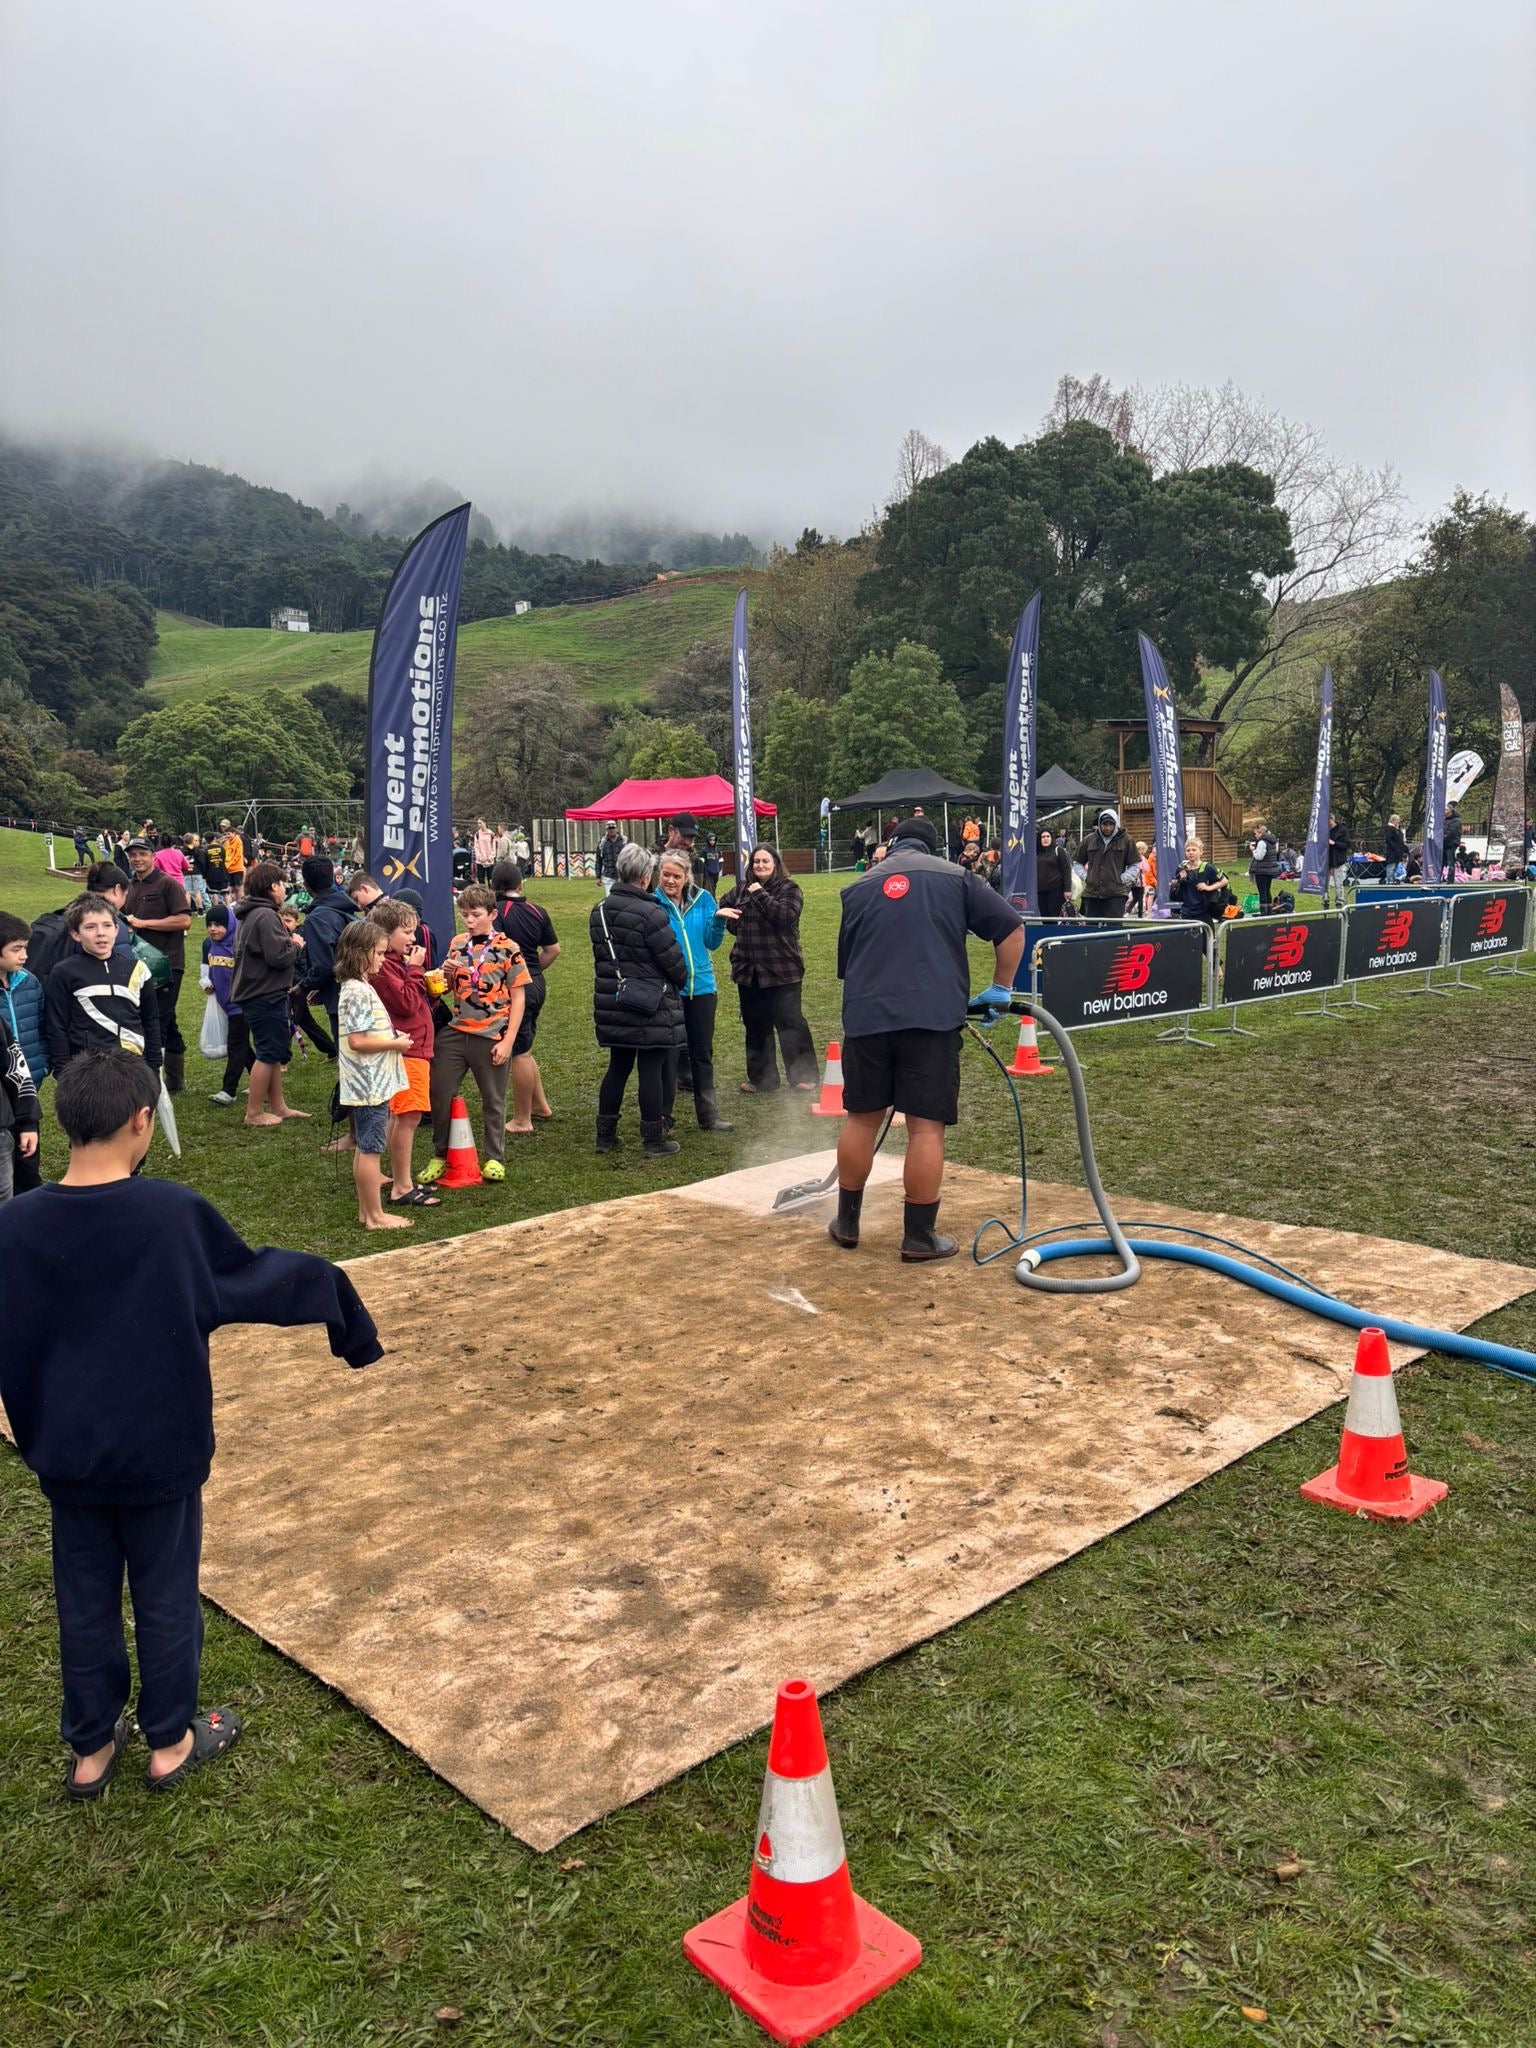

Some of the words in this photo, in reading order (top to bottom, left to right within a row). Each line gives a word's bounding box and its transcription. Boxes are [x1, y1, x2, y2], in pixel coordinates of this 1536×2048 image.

[408, 595, 434, 832] Promotions
[429, 592, 449, 843] www.eventpromotions.co.nz
[383, 732, 405, 850] Event
[1470, 941, 1483, 952] new
[1483, 936, 1508, 950] balance
[1368, 955, 1385, 968] new
[1386, 951, 1417, 965] balance
[1253, 976, 1273, 991] new
[1274, 969, 1312, 987] balance
[1083, 998, 1110, 1015] new
[1114, 990, 1168, 1011] balance
